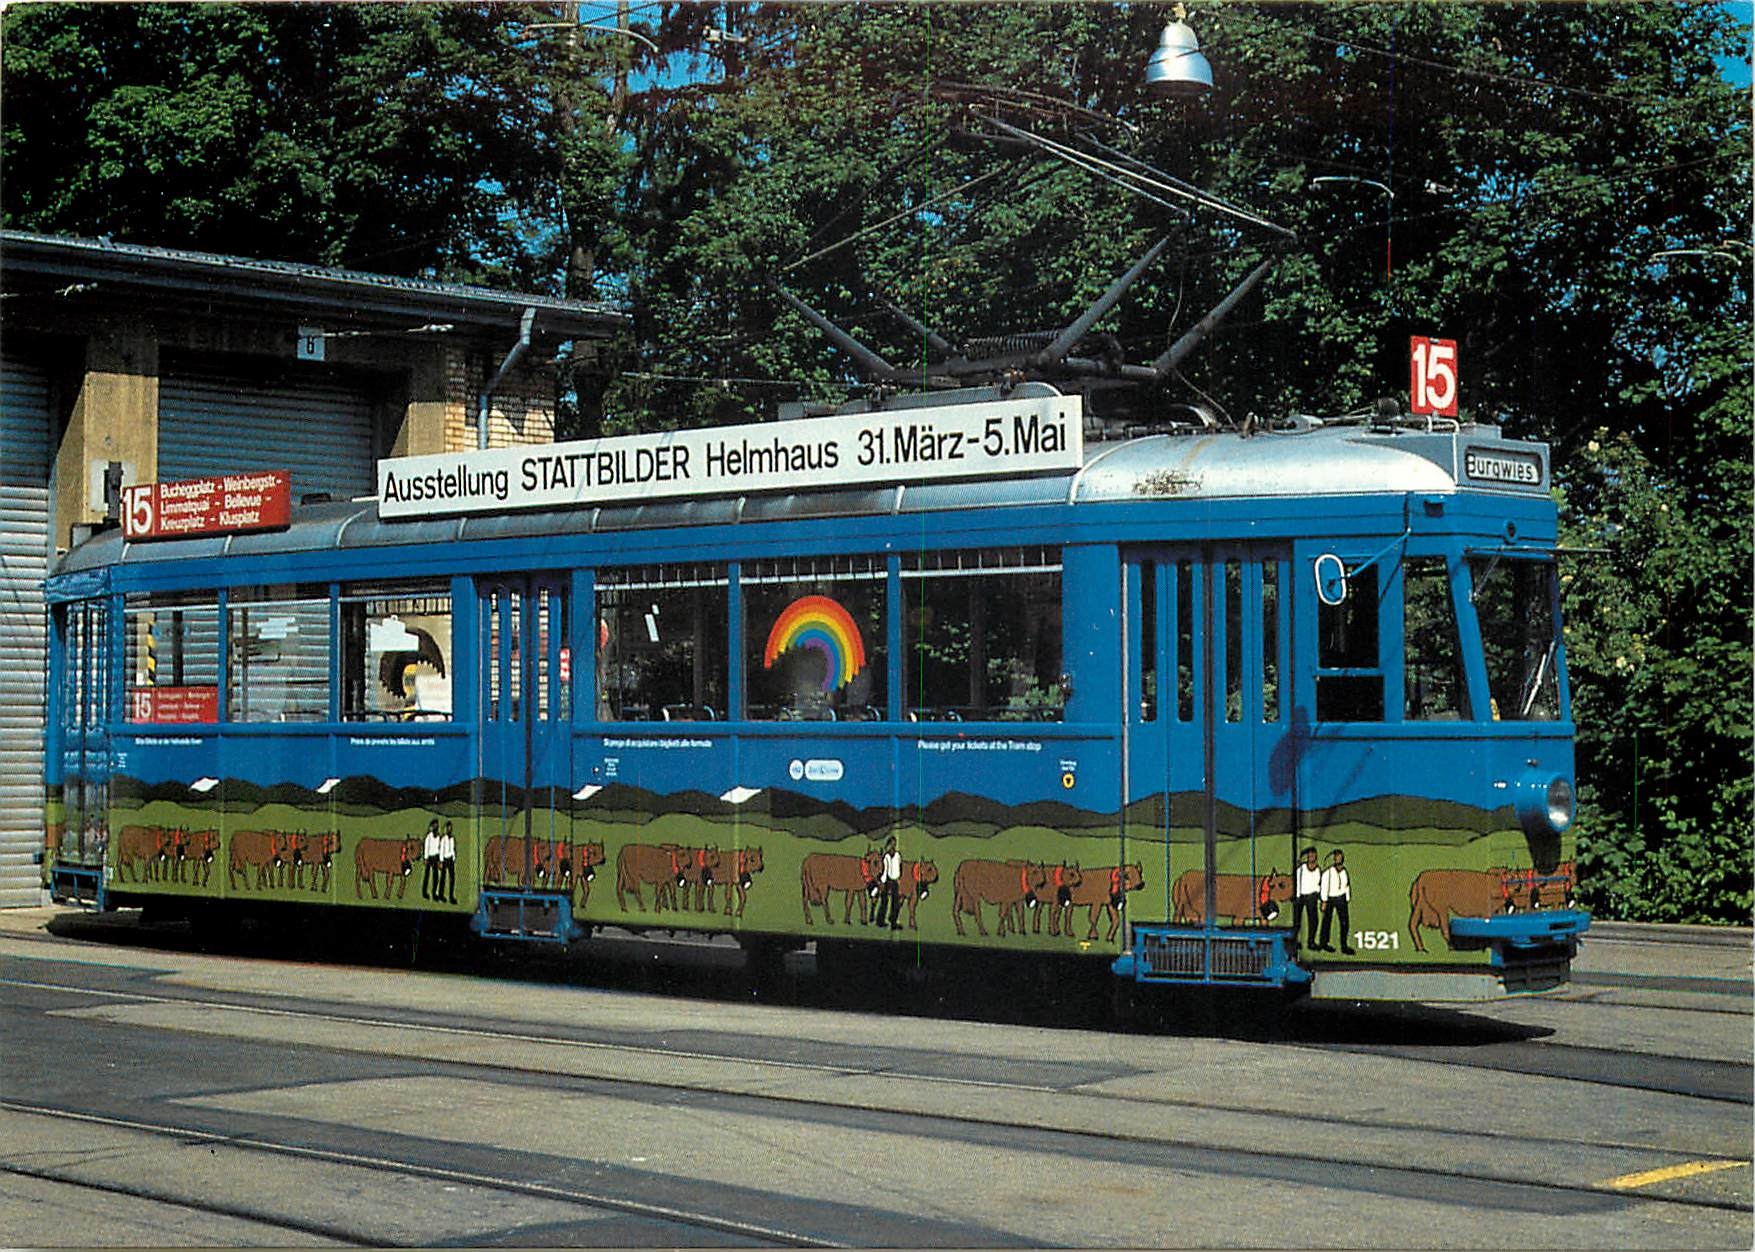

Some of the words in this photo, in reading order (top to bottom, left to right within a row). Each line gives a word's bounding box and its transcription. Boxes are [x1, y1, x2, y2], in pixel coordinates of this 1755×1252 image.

[1412, 343, 1456, 409] 15
[383, 464, 509, 503] Ausstellung
[521, 445, 690, 491] STATTBILDER
[706, 437, 839, 477] Helmhaus
[160, 480, 215, 499] Bucheggplatz
[123, 487, 153, 535] 15
[160, 497, 210, 515] Limmatquai
[224, 494, 262, 509] Bellevue
[160, 516, 205, 532] Kreuzplatz
[219, 510, 260, 527] Klusplatz
[135, 692, 151, 718] 15
[1354, 931, 1399, 949] 1521
